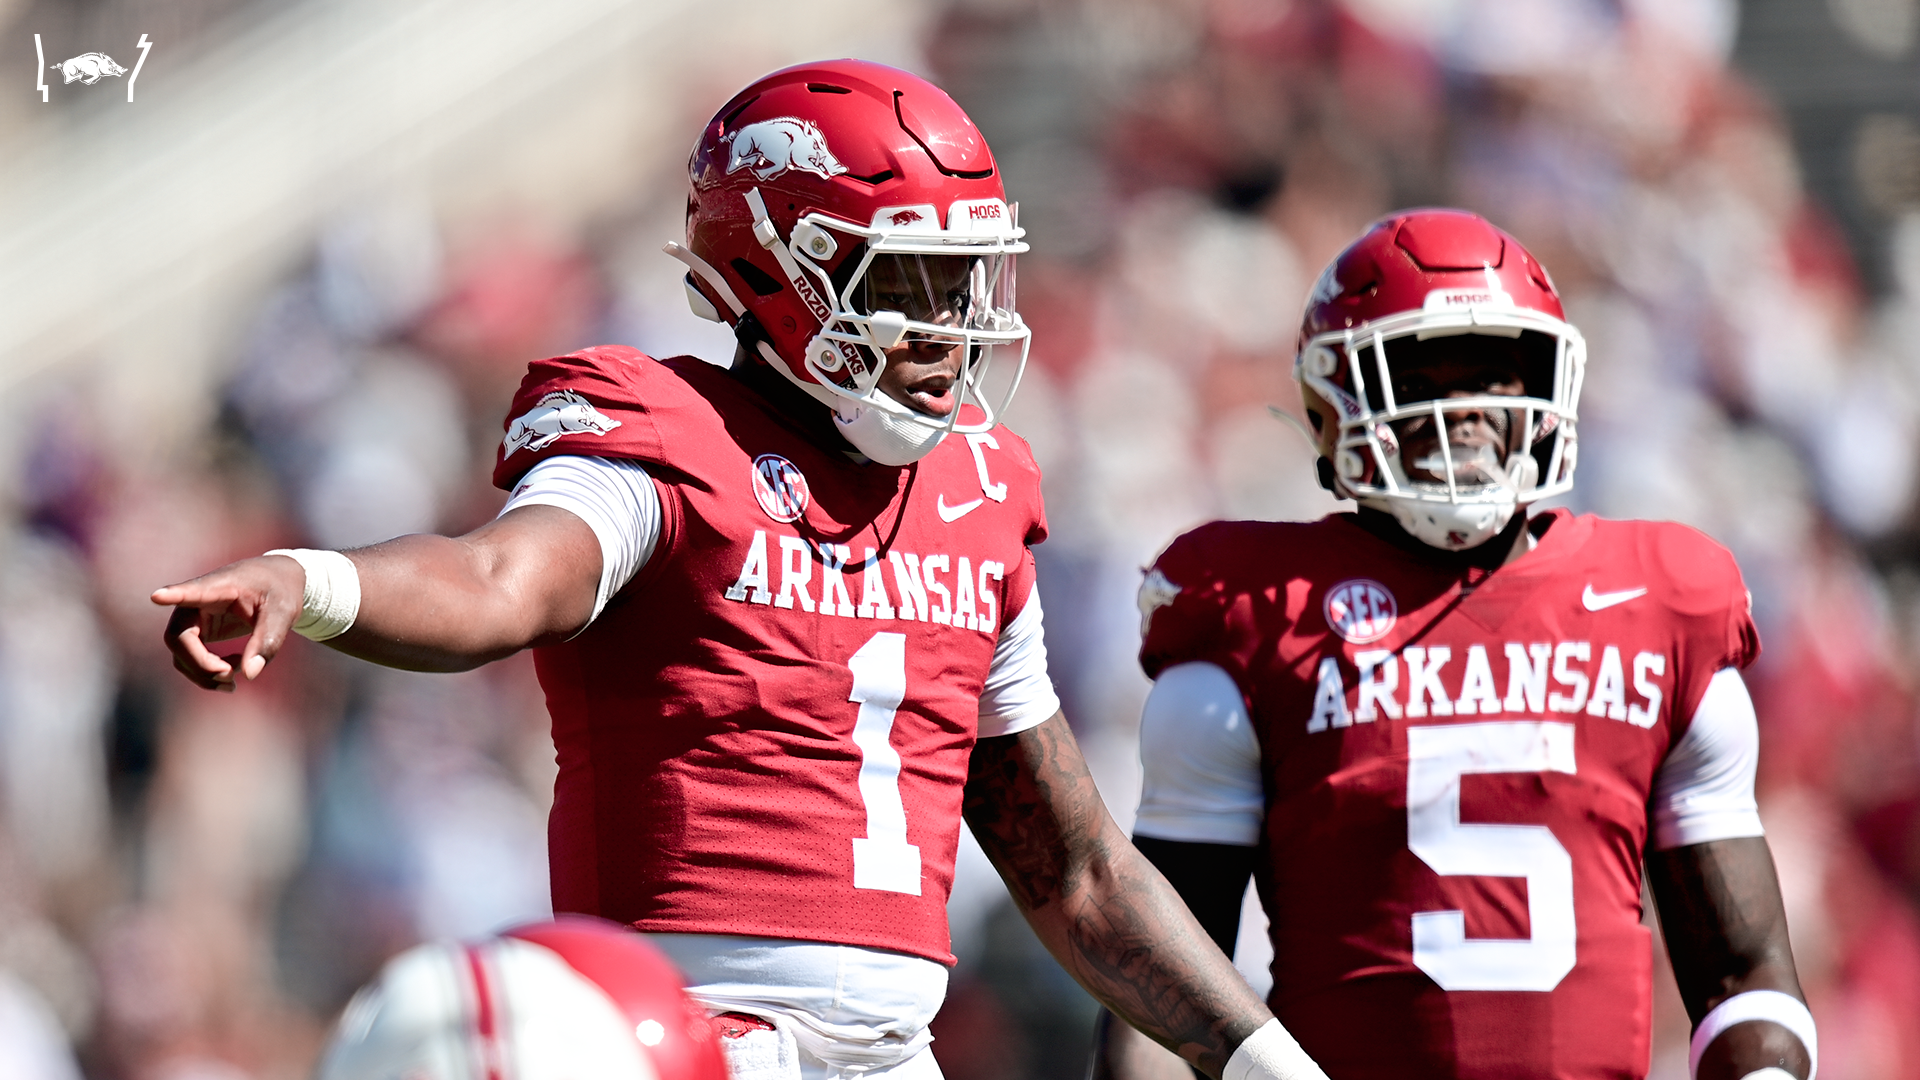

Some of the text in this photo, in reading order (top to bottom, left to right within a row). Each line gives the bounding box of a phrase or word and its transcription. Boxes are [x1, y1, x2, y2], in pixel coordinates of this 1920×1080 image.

[968, 204, 1001, 219] HOGS
[756, 459, 804, 516] SEC
[964, 432, 1008, 504] C
[725, 530, 1005, 633] ARKANSAS
[1329, 584, 1390, 637] SEC
[1308, 642, 1667, 734] ARKANSAS
[848, 631, 922, 896] 1
[1406, 721, 1577, 992] 5
